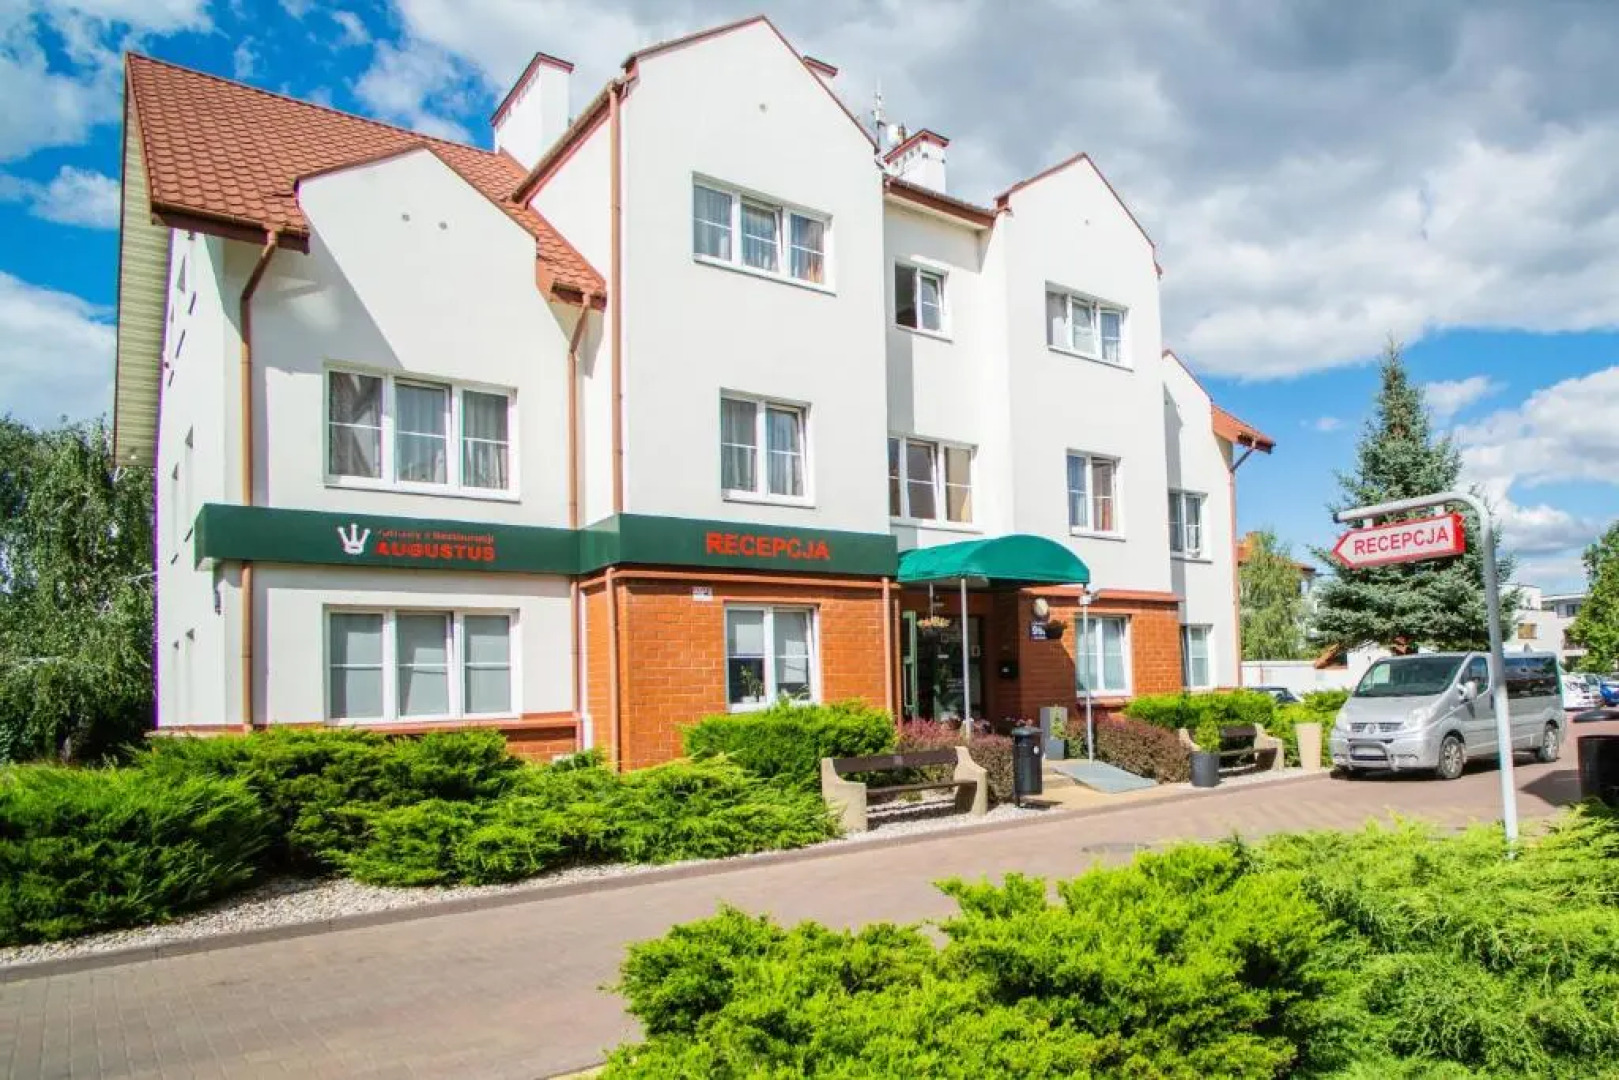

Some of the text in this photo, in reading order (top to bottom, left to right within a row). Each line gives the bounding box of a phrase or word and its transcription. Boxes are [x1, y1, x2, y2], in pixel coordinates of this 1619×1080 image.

[377, 541, 495, 561] AUGUSTUS
[706, 531, 830, 561] RECEPCJA
[1354, 525, 1449, 556] RECEPCJA
